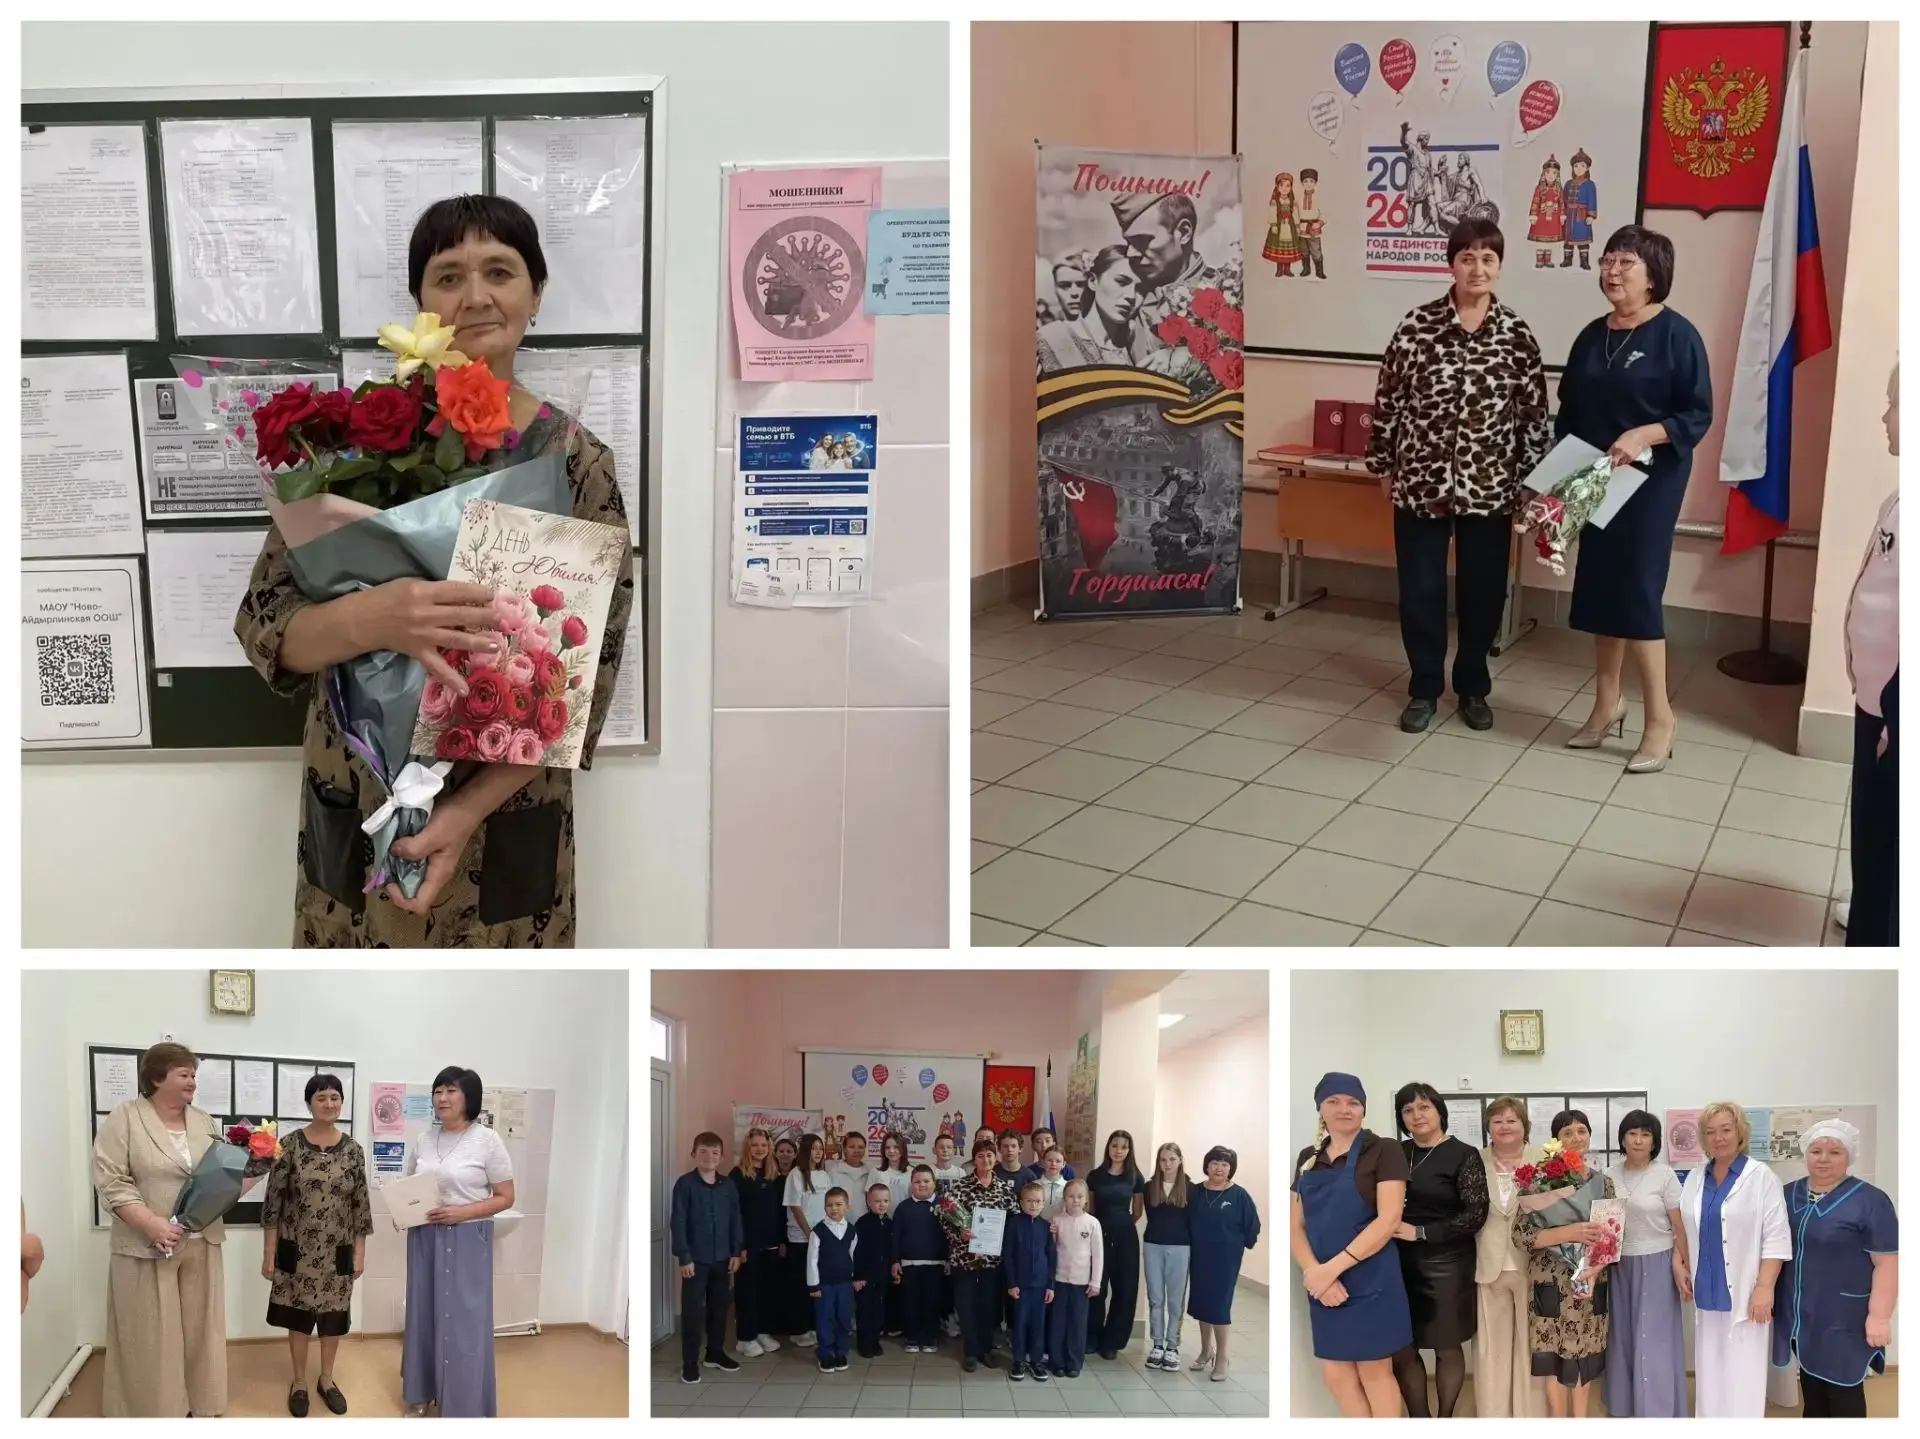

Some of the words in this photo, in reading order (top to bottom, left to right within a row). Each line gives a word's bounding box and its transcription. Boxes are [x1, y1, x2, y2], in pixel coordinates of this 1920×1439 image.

[1367, 156, 1412, 191] 20
[1072, 164, 1211, 198] Помним!
[769, 186, 843, 197] МОШЕННИКИ
[1366, 193, 1408, 228] 26
[1367, 238, 1389, 250] ГОД
[1393, 239, 1448, 250] ЕДИНСТВ
[1366, 251, 1420, 262] НАРОДОВ
[1424, 252, 1449, 262] РОС
[746, 425, 790, 433] Приводите
[780, 432, 795, 440] ВТБ
[158, 477, 177, 498] НЕ
[479, 524, 489, 546] В
[489, 527, 530, 554] ДЕНЬ
[512, 555, 608, 585] Юбилея!
[1068, 564, 1218, 604] Гордимся!
[39, 603, 68, 612] МАОУ
[70, 603, 103, 611] "Ново-
[21, 615, 91, 624] Айдырлинская
[93, 613, 122, 621] ООШ"
[750, 1113, 810, 1128] Помним!
[868, 1111, 888, 1125] 20
[868, 1126, 887, 1140] 26
